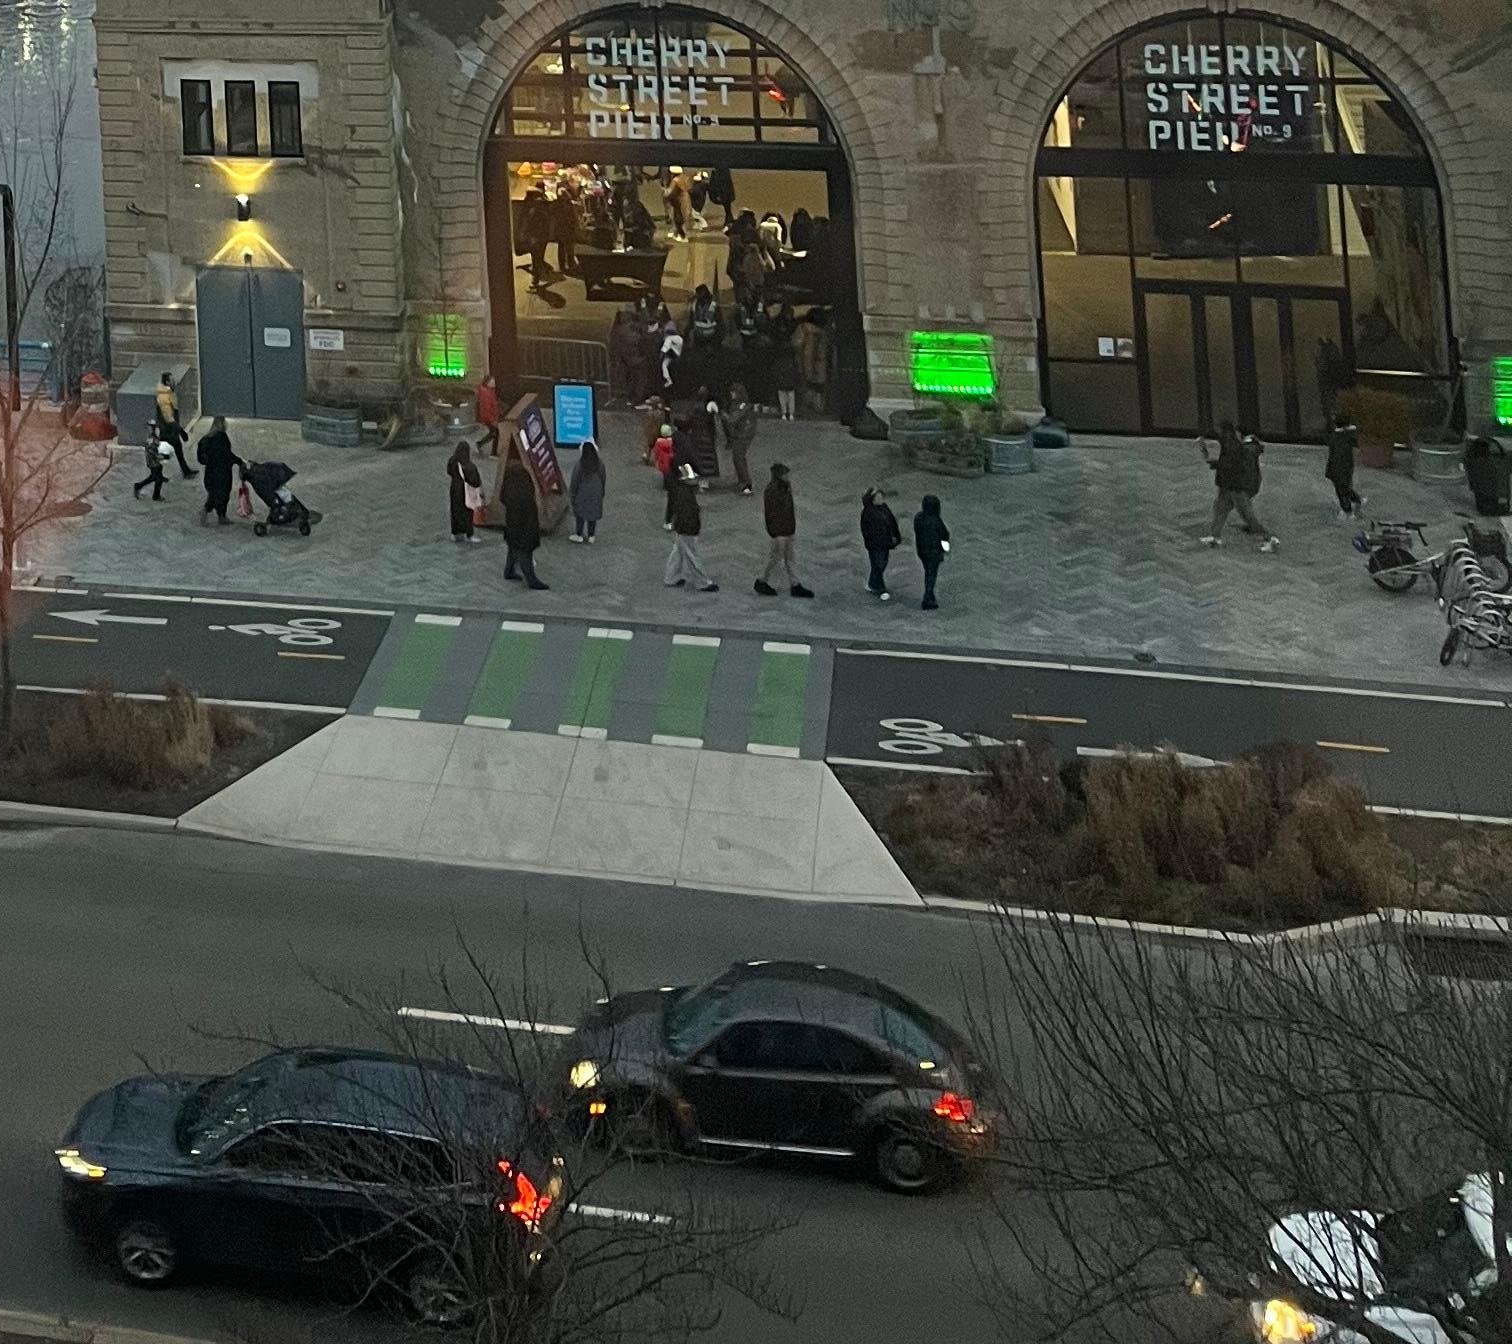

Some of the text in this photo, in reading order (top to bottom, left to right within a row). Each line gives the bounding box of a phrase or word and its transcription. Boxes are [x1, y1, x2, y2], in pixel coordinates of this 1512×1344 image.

[586, 37, 730, 69] CHERRY
[1144, 43, 1306, 77] CHERRY
[588, 74, 734, 106] STREET
[1146, 82, 1309, 116] STREET
[589, 110, 673, 141] PIER
[1148, 119, 1241, 152] PIER
[1282, 123, 1292, 138] 9
